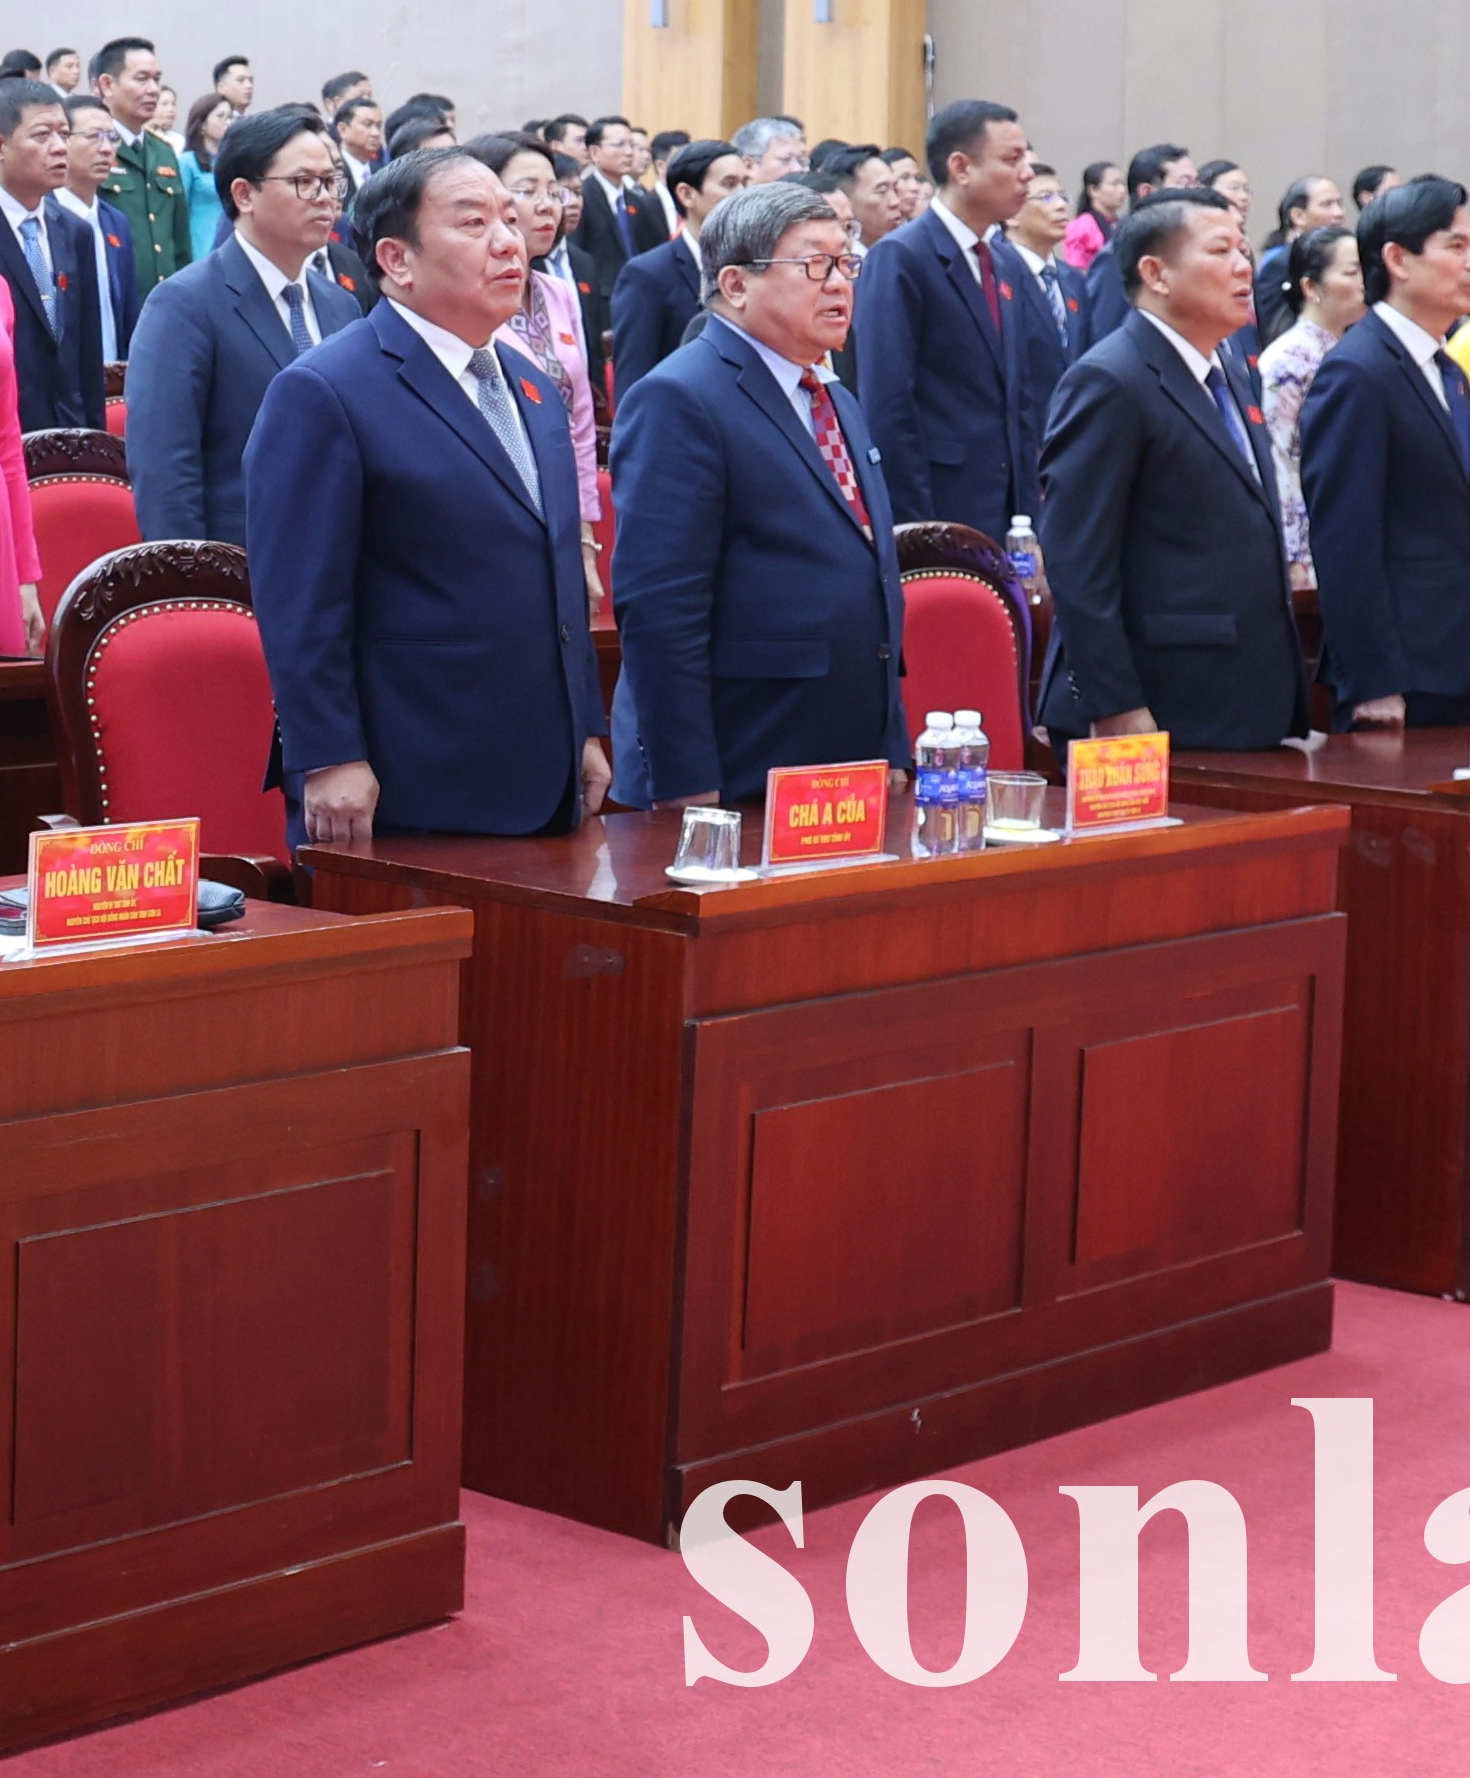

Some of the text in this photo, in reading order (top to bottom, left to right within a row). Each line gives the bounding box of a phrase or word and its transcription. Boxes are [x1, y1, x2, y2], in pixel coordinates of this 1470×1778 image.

[789, 798, 819, 828] CHÁ
[822, 802, 834, 825] A
[90, 839, 144, 855] ĐỒNG CHÍ
[45, 849, 185, 898] HOÀNG VĂN CHẤT
